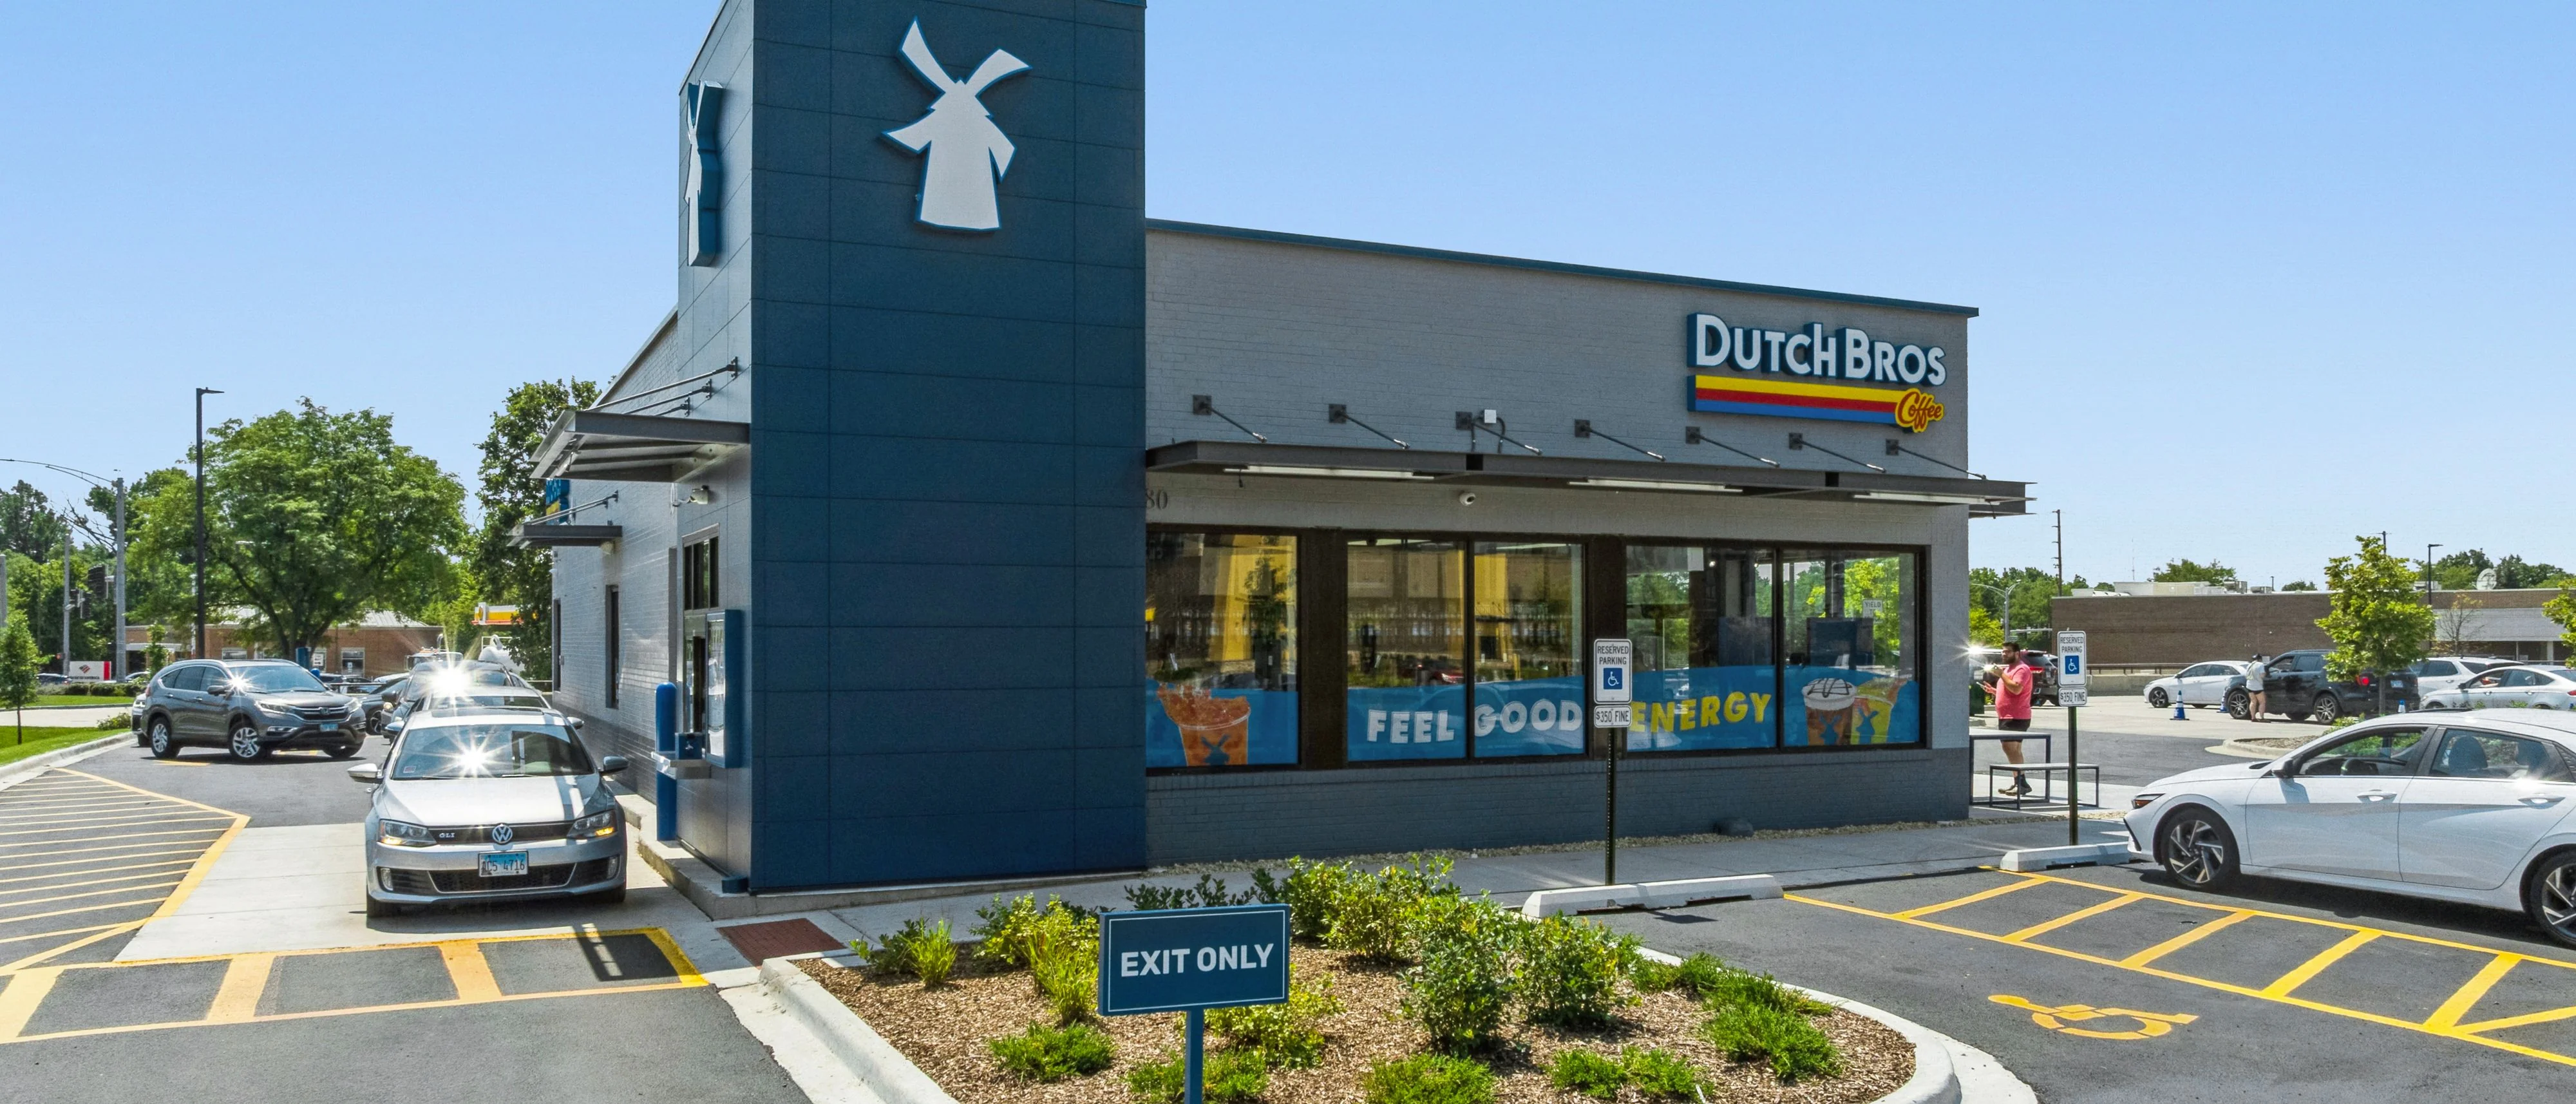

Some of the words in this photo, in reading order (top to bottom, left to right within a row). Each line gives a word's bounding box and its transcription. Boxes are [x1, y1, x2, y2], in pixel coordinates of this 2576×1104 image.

[1845, 327, 1947, 386] BROS
[1897, 391, 1942, 430] Coffee
[1597, 645, 1629, 654] RESERVED
[2061, 691, 2073, 702] $350
[2074, 691, 2085, 702] FINE
[1367, 709, 1455, 744] FEEL
[1473, 698, 1583, 738] GOOD
[1629, 690, 1771, 733] ENERGY
[1596, 710, 1613, 723] $350
[1615, 710, 1629, 722] FINE
[504, 859, 525, 871] 4716
[1121, 947, 1191, 978] EXIT
[1197, 942, 1274, 973] ONLY
